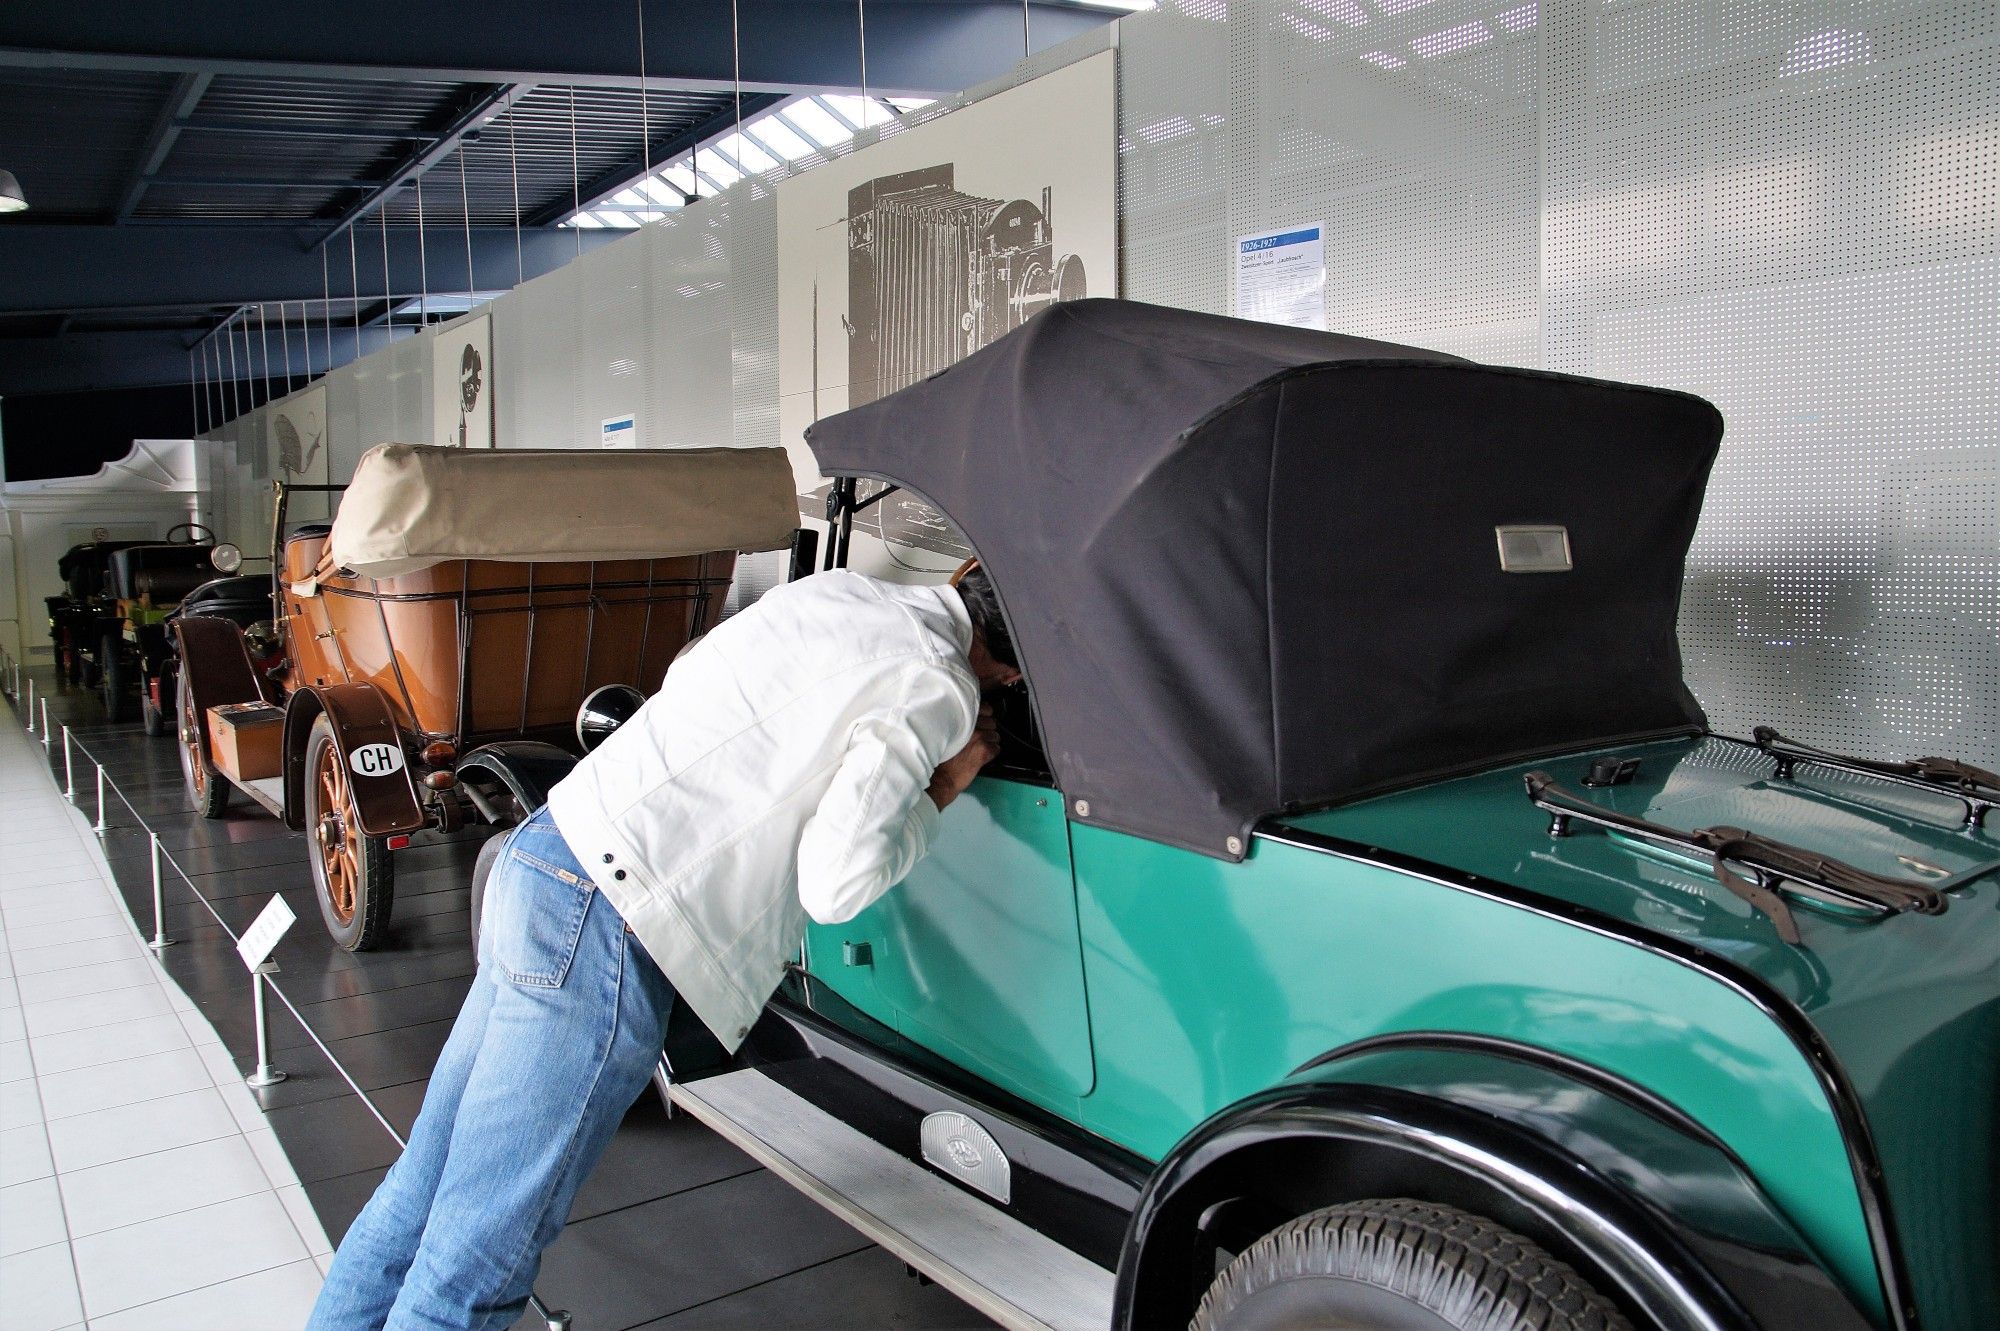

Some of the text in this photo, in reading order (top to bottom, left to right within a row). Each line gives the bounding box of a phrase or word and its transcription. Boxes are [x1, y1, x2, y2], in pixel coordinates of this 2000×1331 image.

[1241, 238, 1277, 252] 1926-1927
[1241, 254, 1256, 263] Opel
[360, 747, 393, 772] CH
